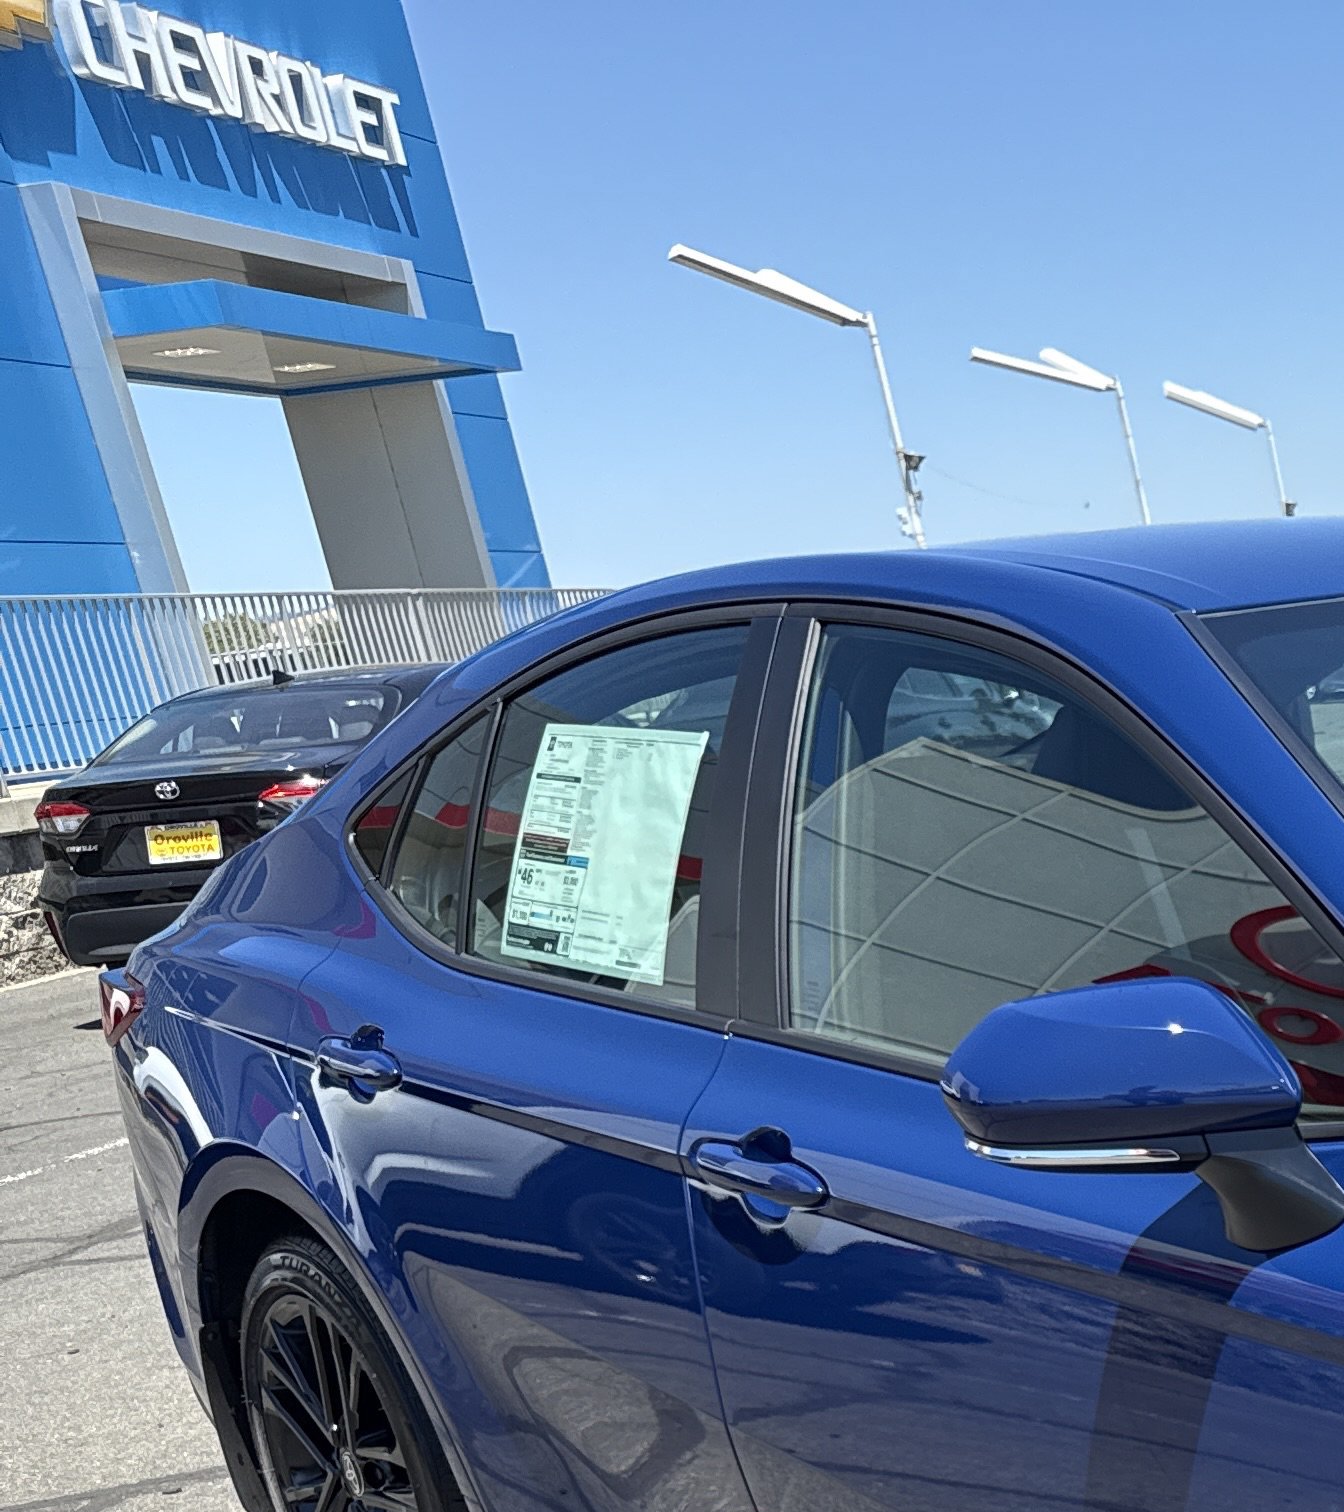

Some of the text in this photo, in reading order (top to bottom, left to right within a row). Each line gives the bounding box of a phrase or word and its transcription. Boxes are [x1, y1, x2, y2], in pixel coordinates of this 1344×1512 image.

[53, 0, 408, 167] CHEVROLET
[153, 830, 213, 846] Oroville
[169, 843, 215, 855] TOYOTA
